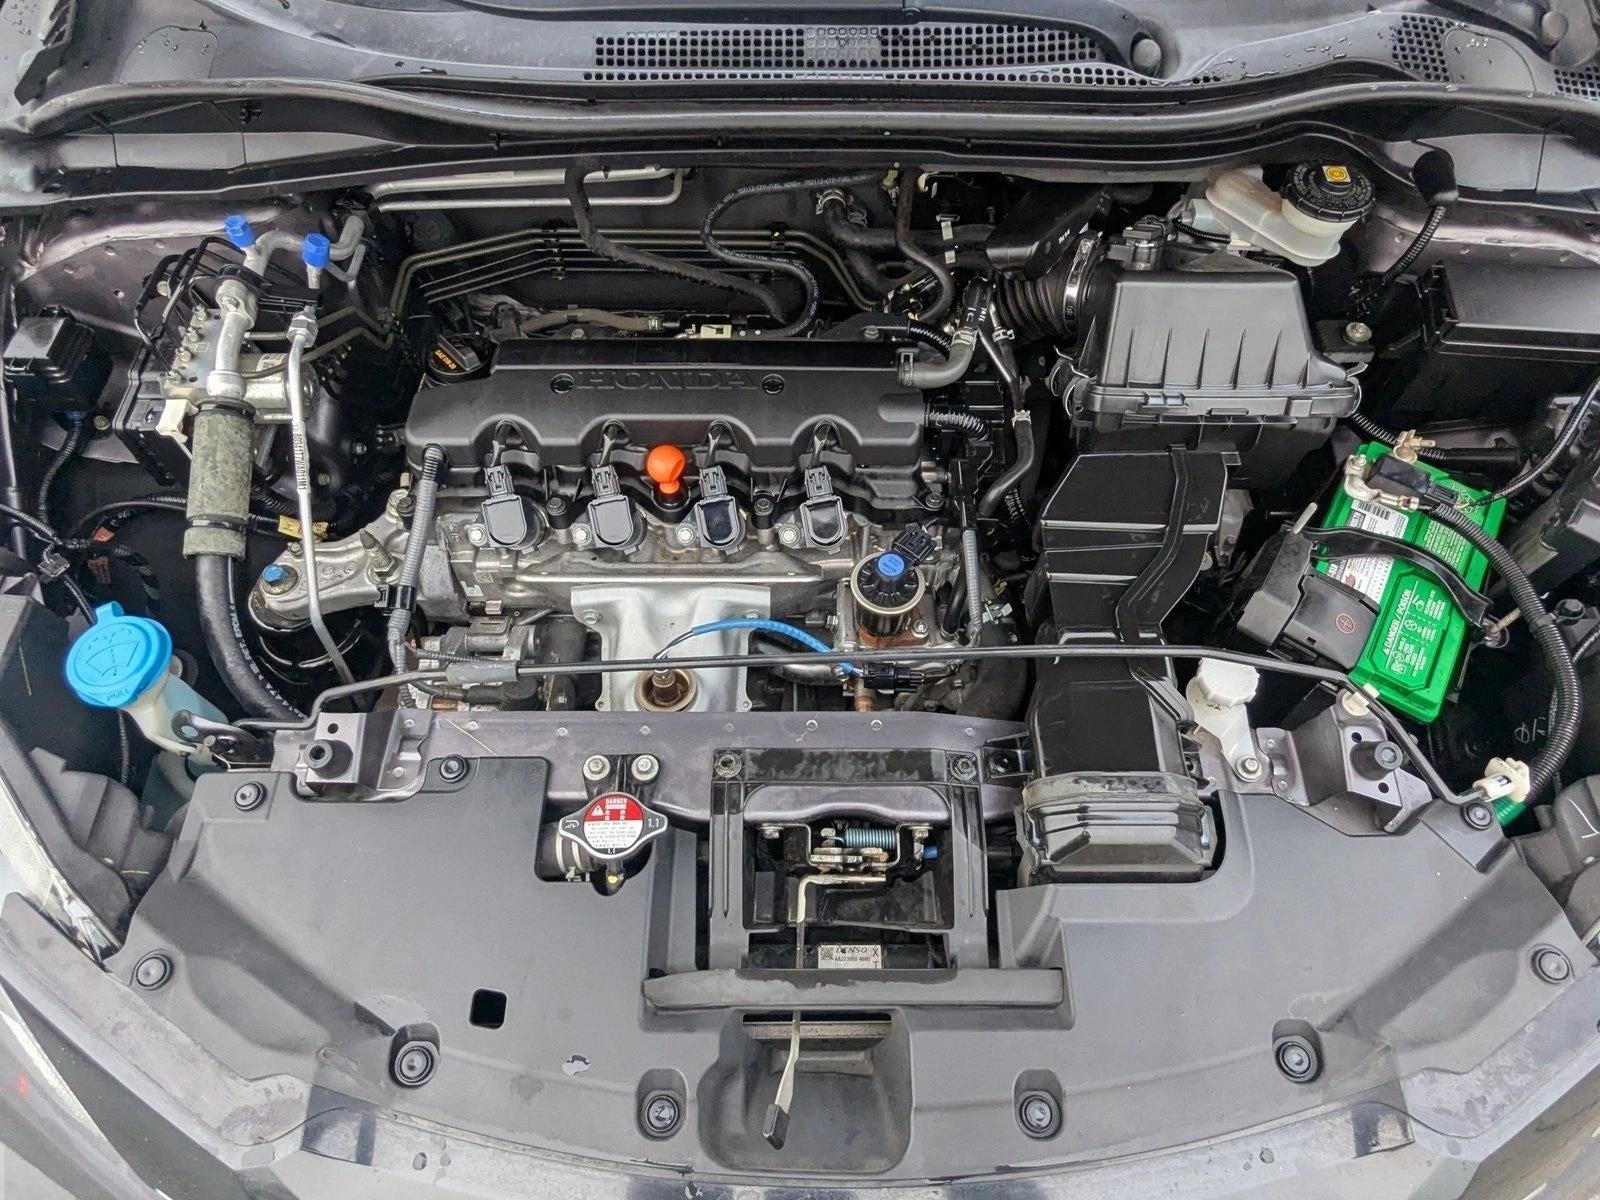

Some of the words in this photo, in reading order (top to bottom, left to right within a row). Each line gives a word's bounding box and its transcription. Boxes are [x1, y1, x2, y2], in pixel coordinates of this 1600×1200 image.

[577, 372, 758, 389] HONDA
[1384, 619, 1400, 648] DANGER
[1397, 589, 1411, 615] POISON
